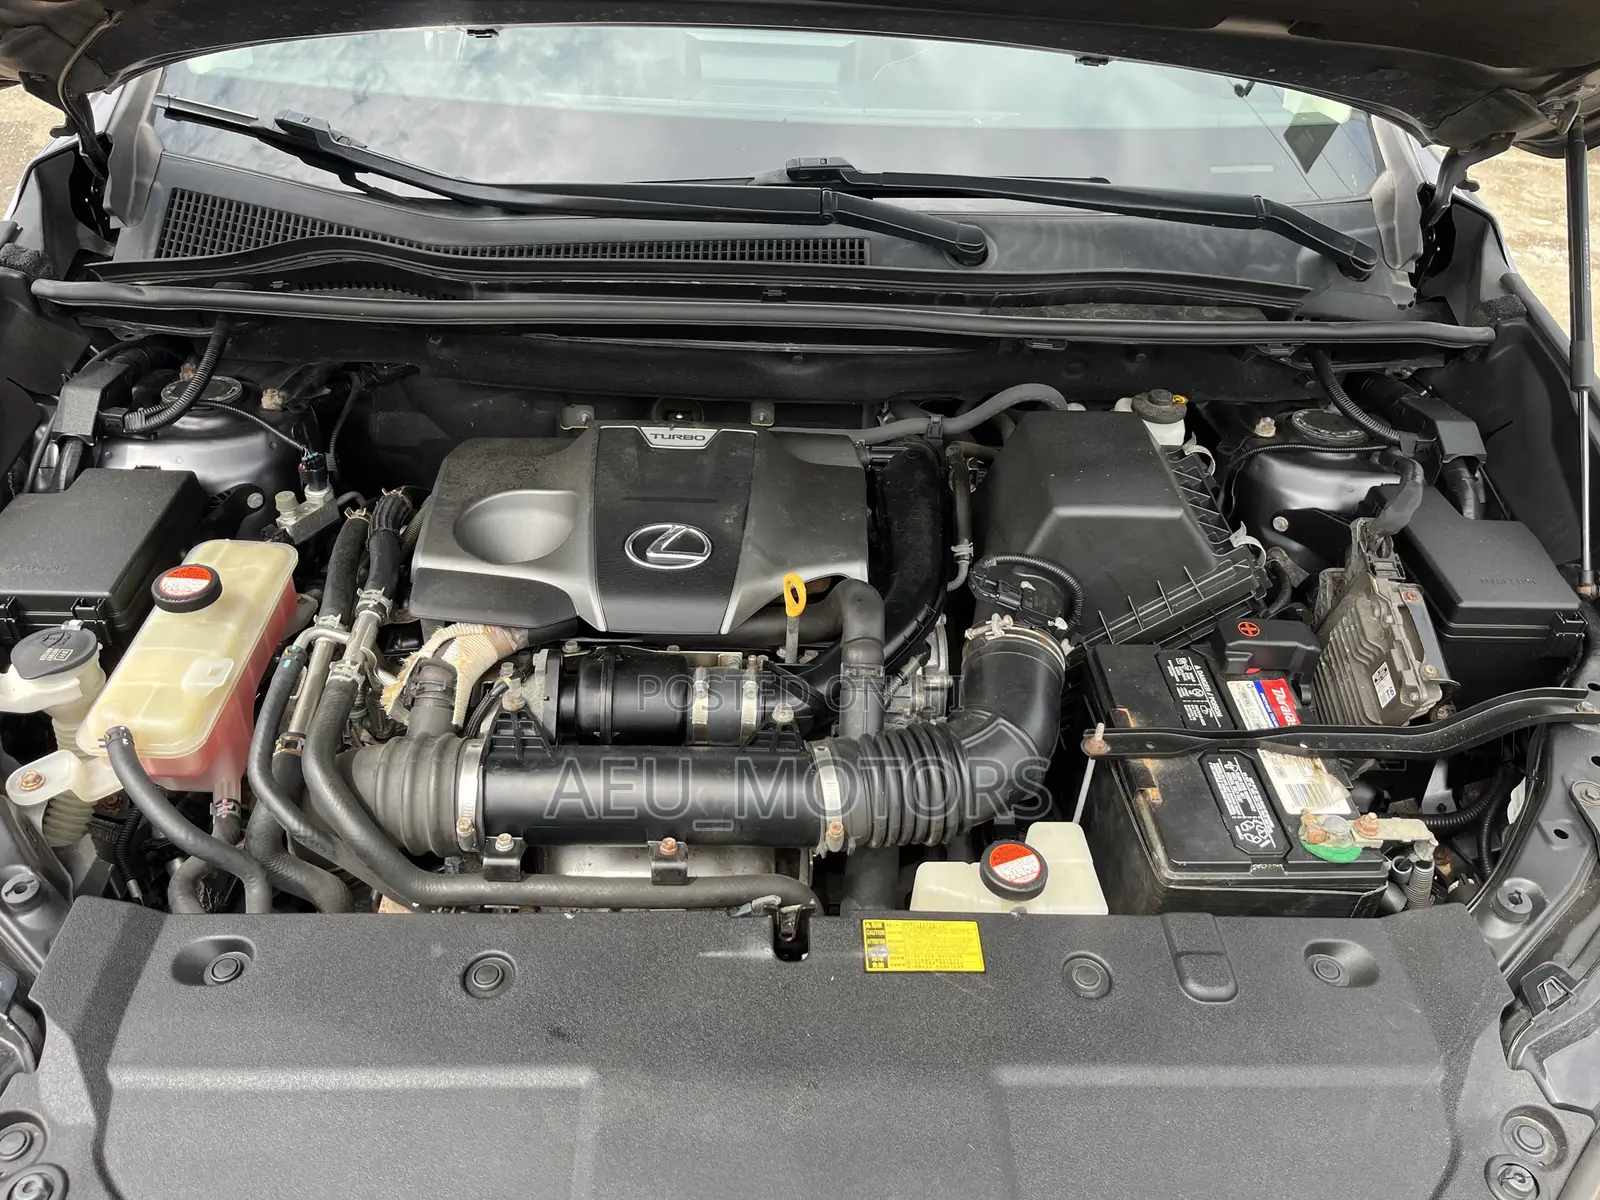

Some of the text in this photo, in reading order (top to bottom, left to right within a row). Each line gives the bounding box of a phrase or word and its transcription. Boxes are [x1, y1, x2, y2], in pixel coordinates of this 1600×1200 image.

[650, 433, 706, 441] TURBO
[1196, 669, 1212, 692] DANGER
[1208, 696, 1224, 717] POISON
